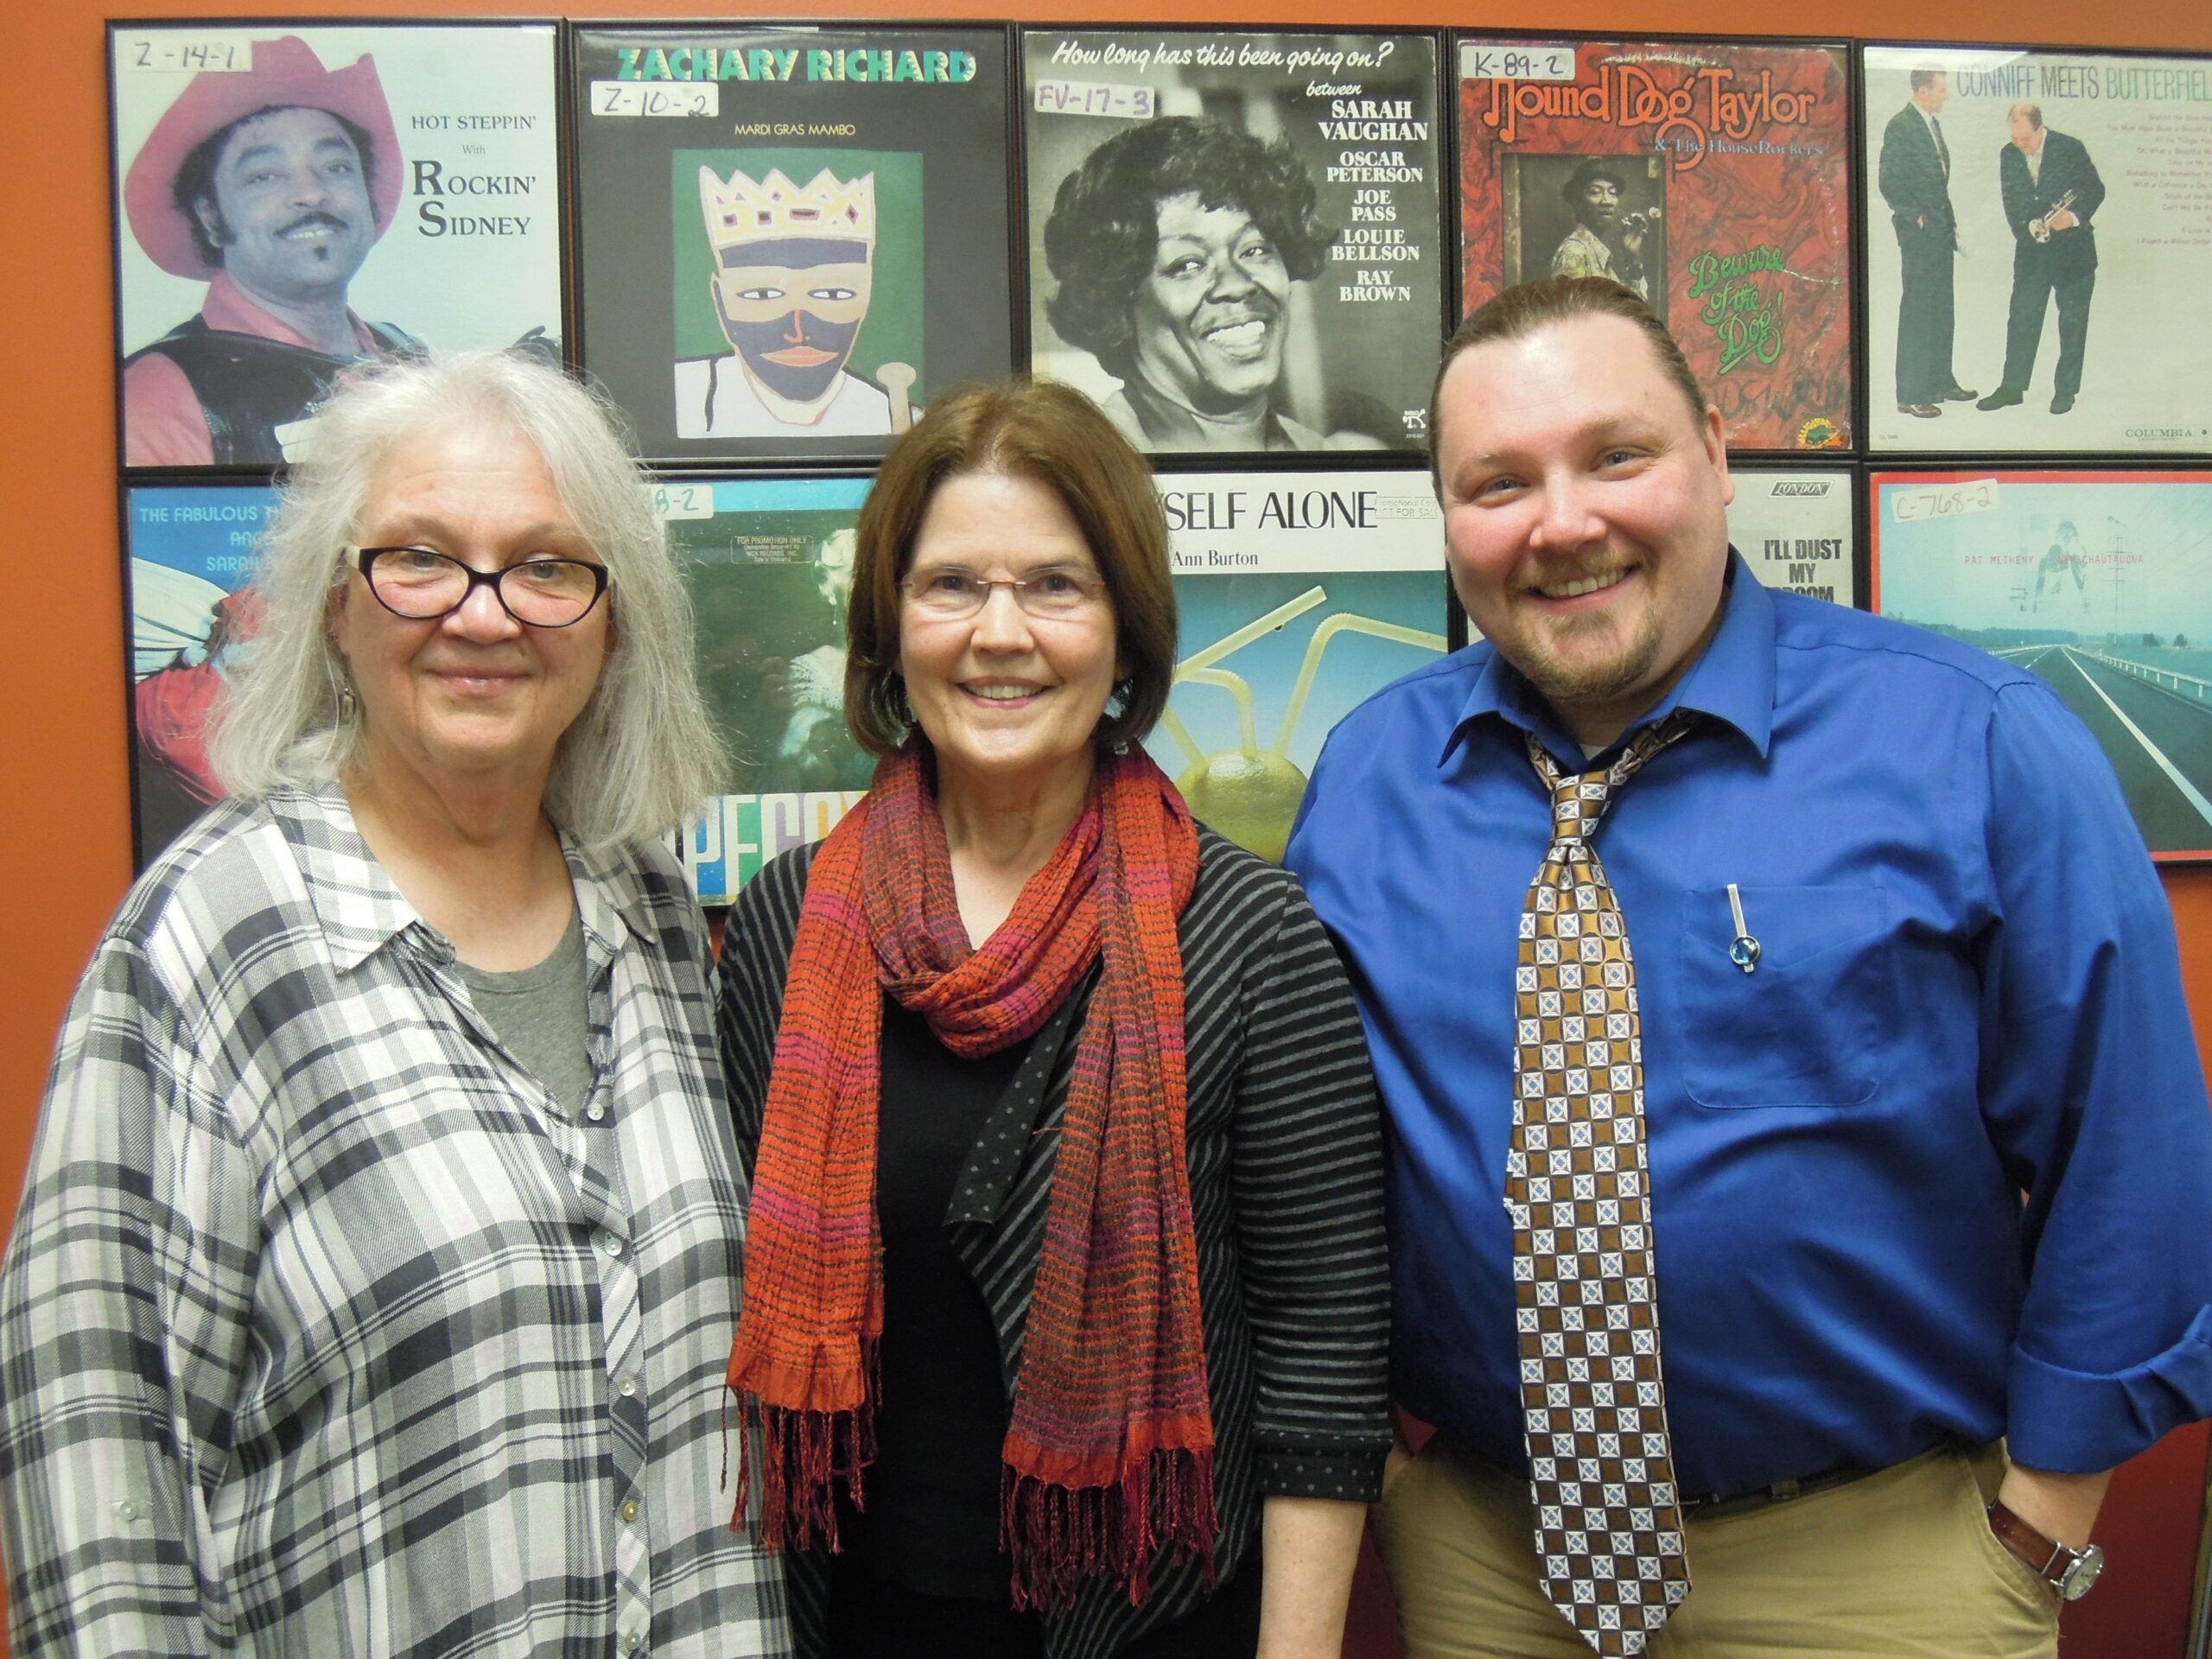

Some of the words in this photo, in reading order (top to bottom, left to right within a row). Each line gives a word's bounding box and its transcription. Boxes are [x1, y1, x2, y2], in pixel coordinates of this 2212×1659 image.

[135, 41, 234, 69] Z-14-1
[1051, 41, 1103, 65] How
[1103, 43, 1151, 73] long
[1153, 41, 1192, 67] has
[1196, 43, 1236, 67] this
[1238, 43, 1285, 67] been
[1287, 47, 1345, 74] going
[1346, 41, 1395, 67] on?
[617, 48, 798, 82] ZACHARY
[806, 49, 977, 83] RICHARD
[1474, 51, 1565, 78] K-89-2
[1306, 80, 1362, 97] between
[1956, 64, 2036, 97] CONNIFF
[2041, 66, 2100, 99] MEETS
[2106, 67, 2212, 102] BUTTERFIEL
[604, 87, 710, 118] Z-10-2
[1038, 85, 1150, 116] FV-17-3
[1698, 67, 1815, 139] Taylor
[1332, 100, 1412, 119] SARAH
[411, 116, 451, 130] HOT
[456, 116, 537, 130] STEPPIN'
[734, 124, 771, 136] MARDI
[774, 124, 805, 136] GRAS
[808, 124, 855, 136] MAMBO
[1318, 122, 1428, 141] VAUGHAN
[461, 143, 486, 155] With
[1654, 138, 1667, 152] &
[1675, 138, 1704, 152] The
[1339, 151, 1407, 167] OSCAR
[412, 159, 537, 196] ROCKIN'
[1326, 167, 1423, 183] PETERSON
[1354, 189, 1391, 205] JOE
[418, 201, 531, 237] SIDNEY
[1351, 207, 1396, 221] PASS
[1344, 229, 1406, 245] LOUIE
[1332, 246, 1420, 261] BELLSON
[1357, 270, 1393, 285] RAY
[1688, 245, 1786, 298] Beware
[1339, 286, 1411, 302] BROWN
[1701, 278, 1733, 325] of
[1729, 281, 1760, 313] the
[2125, 429, 2192, 438] COLUMBIA
[1774, 482, 1826, 496] LONDON
[1163, 490, 1247, 531] SELF
[1258, 490, 1378, 529] ALONE
[1897, 486, 1992, 520] C-768-2
[140, 507, 168, 522] THE
[174, 506, 258, 522] FABULOUS
[737, 536, 750, 545] FOR
[751, 536, 788, 544] PROMOTION
[1764, 539, 1792, 560] I'LL
[1795, 539, 1842, 560] DUST
[207, 556, 259, 571] SARAH
[1172, 550, 1203, 566] Ann
[1208, 550, 1259, 566] Burton
[1964, 556, 1983, 564] PAT
[1990, 556, 2034, 564] METHENY
[2082, 554, 2144, 564] CHAUTAUQUA
[1789, 563, 1816, 583] MY
